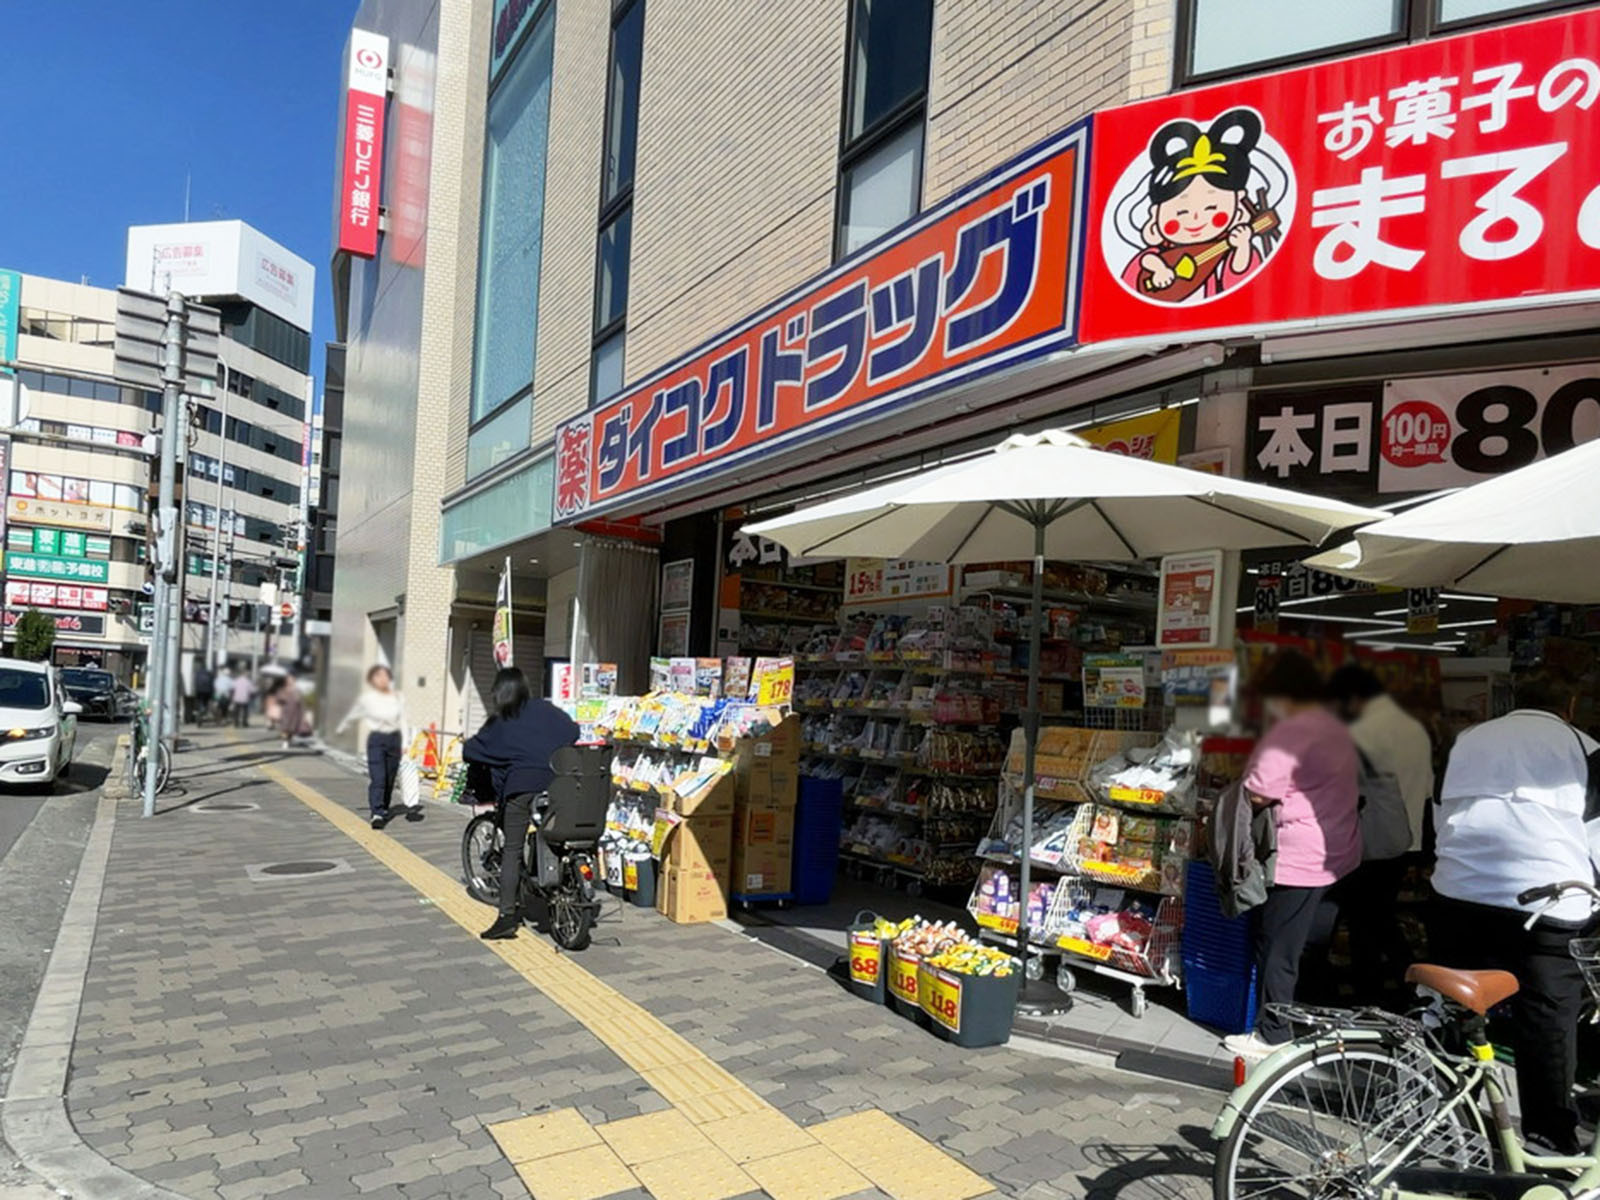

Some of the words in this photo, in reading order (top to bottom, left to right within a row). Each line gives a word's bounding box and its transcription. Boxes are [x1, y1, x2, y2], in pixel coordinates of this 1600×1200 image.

[1317, 58, 1600, 160] お菓子の
[351, 103, 375, 227] 三菱UFJ銀行
[1311, 141, 1600, 281] まる
[598, 172, 1051, 495] ダイコクドラッグ
[556, 424, 590, 514] 薬
[1256, 402, 1374, 478] 本日
[1386, 411, 1447, 445] 100円
[770, 679, 792, 701] 178
[851, 957, 877, 978] 68
[930, 989, 957, 1019] 118
